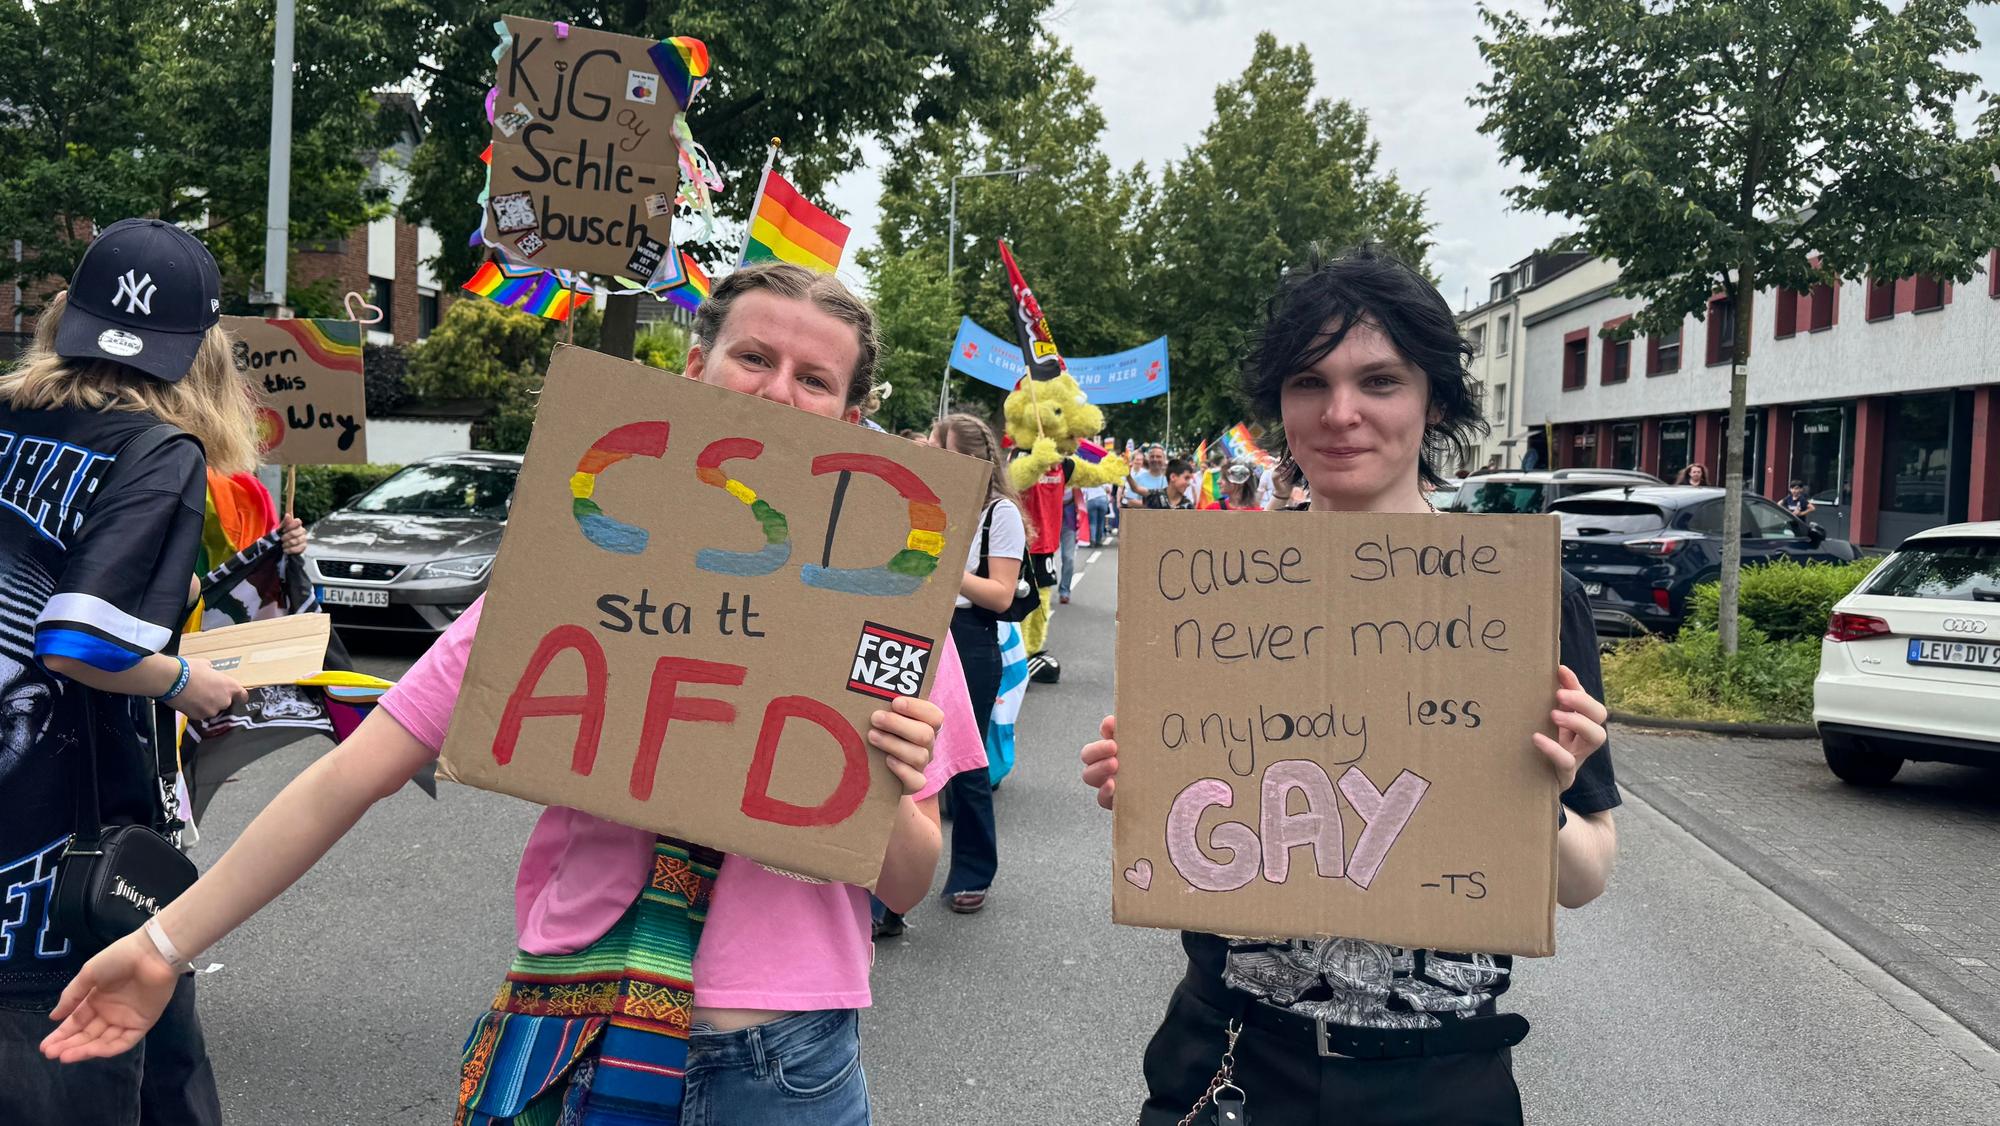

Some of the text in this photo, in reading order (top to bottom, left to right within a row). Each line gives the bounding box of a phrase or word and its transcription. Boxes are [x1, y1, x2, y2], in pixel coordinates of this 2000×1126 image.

[512, 123, 656, 193] Schle-
[542, 195, 648, 248] busch
[232, 341, 297, 371] Born
[1108, 367, 1138, 383] HIER
[263, 374, 306, 393] this
[287, 404, 361, 451] Way
[569, 420, 947, 596] CSD
[1157, 534, 1502, 600] cause shade
[858, 633, 929, 673] FCK
[1173, 604, 1508, 661] never made
[1920, 642, 1953, 661] LEV
[1965, 645, 1990, 664] DV
[851, 656, 920, 695] NZS
[491, 624, 871, 827] AFD
[1161, 691, 1482, 777] anybody less
[1165, 758, 1432, 892] GAY
